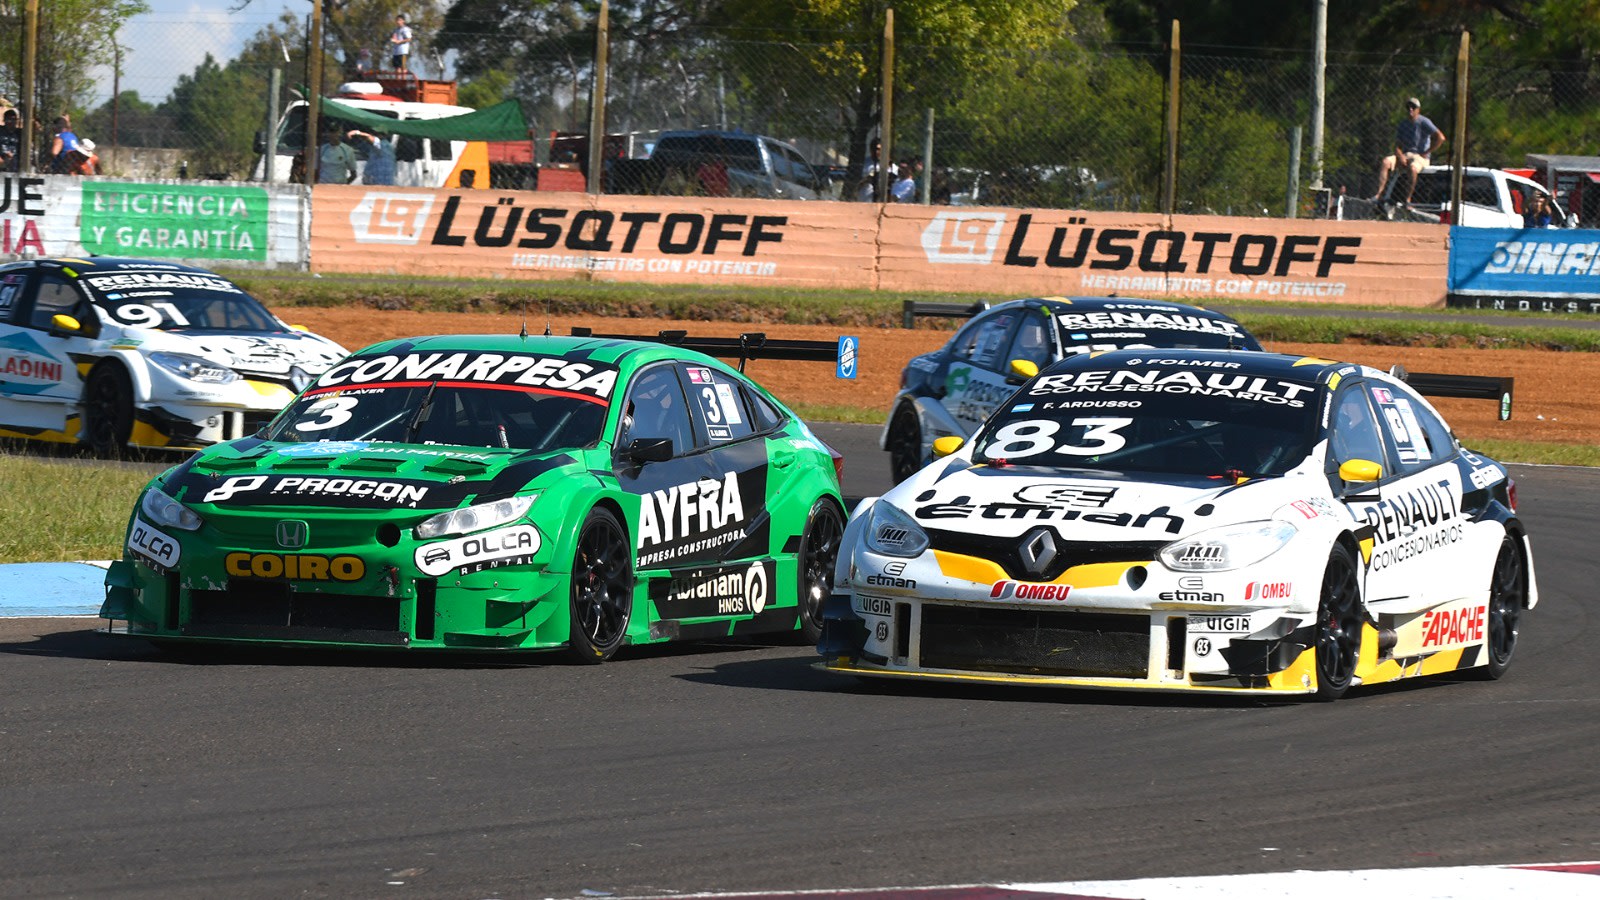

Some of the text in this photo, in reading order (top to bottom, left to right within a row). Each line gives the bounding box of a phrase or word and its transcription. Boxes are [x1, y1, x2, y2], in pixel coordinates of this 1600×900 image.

[94, 191, 249, 217] EFICIENCIA
[93, 224, 255, 251] Y GARANTÍA
[431, 196, 788, 257] LÜSQTOFF
[1003, 213, 1362, 278] LÜSQTOFF
[512, 252, 777, 276] HERRAMIENTAS CON POTENCIA
[88, 273, 234, 289] RENAULT
[1081, 273, 1347, 296] HERRAMIENTAS CON POTENCIA
[117, 302, 191, 329] 91
[1115, 303, 1180, 312] FOLMER
[1058, 312, 1239, 333] RENAULT
[0, 356, 63, 382] ADINI
[317, 352, 617, 399] CONARPESA
[1146, 358, 1242, 369] FOLMER
[339, 388, 385, 396] LLAVER
[1028, 384, 1306, 408] CONCESIONARIOS
[1031, 370, 1316, 400] RENAULT
[295, 397, 359, 432] 3
[702, 387, 721, 423] 3
[1043, 400, 1143, 409] F. ARDUSSO
[984, 416, 1134, 460] 83
[274, 477, 429, 502] PROCON
[637, 470, 744, 549] AYFRA
[1364, 479, 1458, 547] RENAULT
[133, 527, 174, 560] OLCA
[462, 531, 532, 557] OLCA
[635, 528, 747, 568] EMPRESA CONSTRUCTORA
[1373, 523, 1463, 572] CONCESIONARIOS
[224, 551, 366, 582] COIRO
[461, 556, 534, 576] RENTAL
[867, 573, 917, 589] etman
[1015, 584, 1071, 602] OMBU
[1262, 581, 1292, 599] OMBU
[718, 597, 744, 614] HNOS
[1158, 589, 1224, 602] etman
[877, 622, 888, 640] 83
[1422, 605, 1486, 648] APACHE
[1196, 639, 1210, 654] 83
